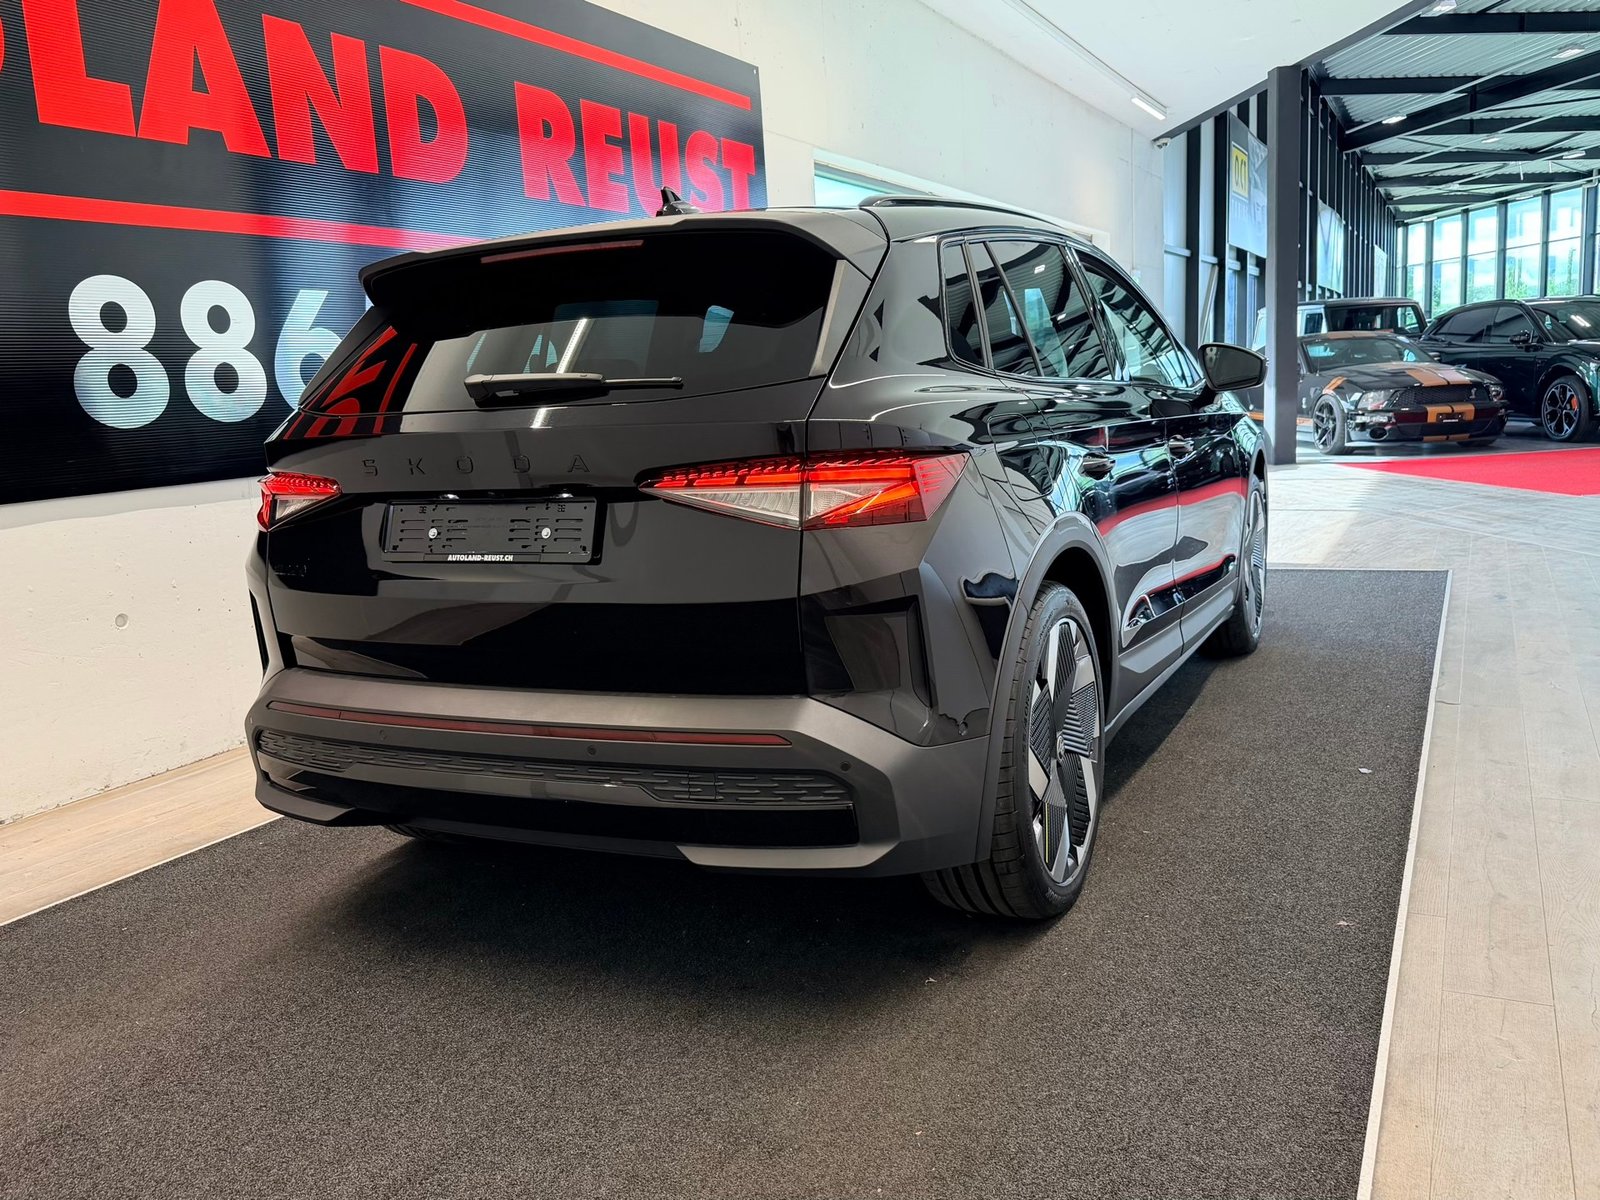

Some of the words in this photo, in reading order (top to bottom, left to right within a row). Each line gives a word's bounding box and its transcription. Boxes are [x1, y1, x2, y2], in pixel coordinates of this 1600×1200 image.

[0, 0, 469, 184] LAND
[513, 80, 757, 218] REUST
[361, 454, 591, 477] SKODA
[447, 554, 514, 562] AUTOLAND-REUST.CH
